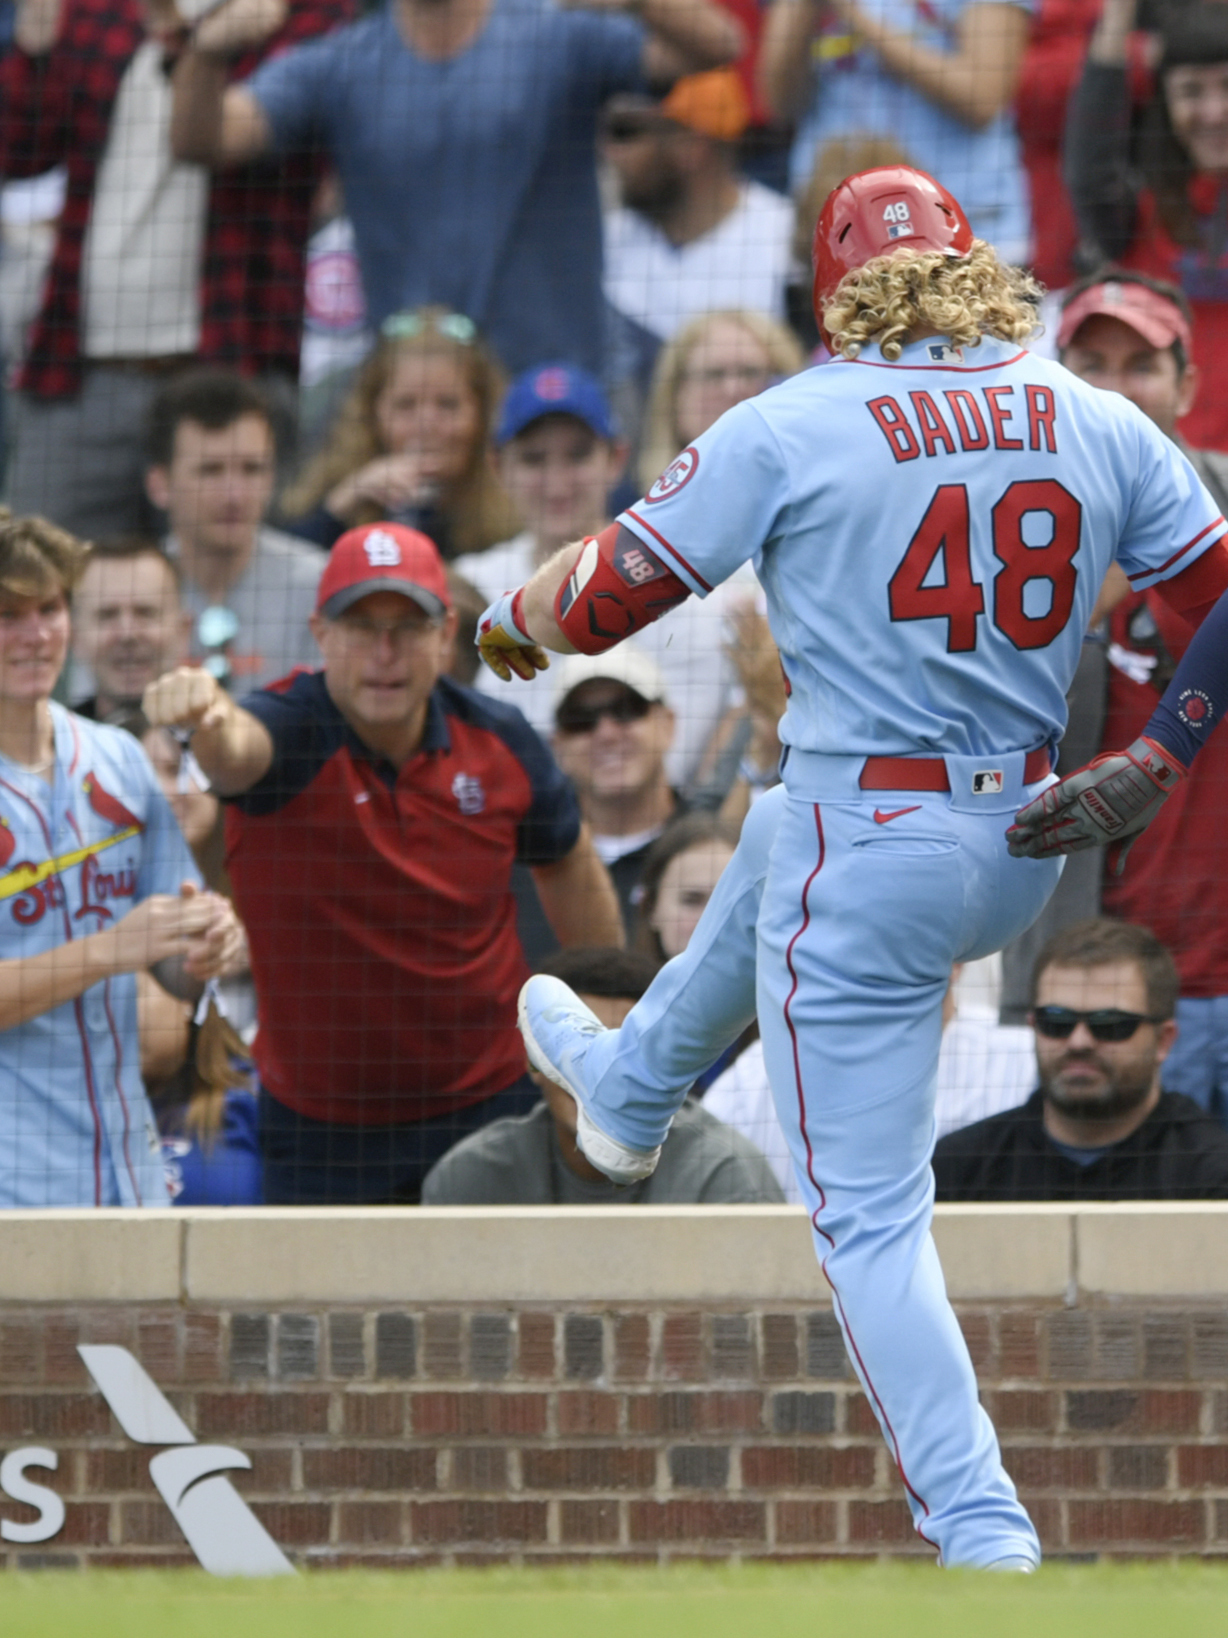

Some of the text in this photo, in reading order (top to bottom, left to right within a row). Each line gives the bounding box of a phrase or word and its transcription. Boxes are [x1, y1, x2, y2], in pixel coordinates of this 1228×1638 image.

[882, 201, 910, 223] 48
[865, 384, 1057, 464] BADER
[622, 549, 655, 582] 48
[887, 478, 1082, 653] 48
[0, 1446, 66, 1543] S
